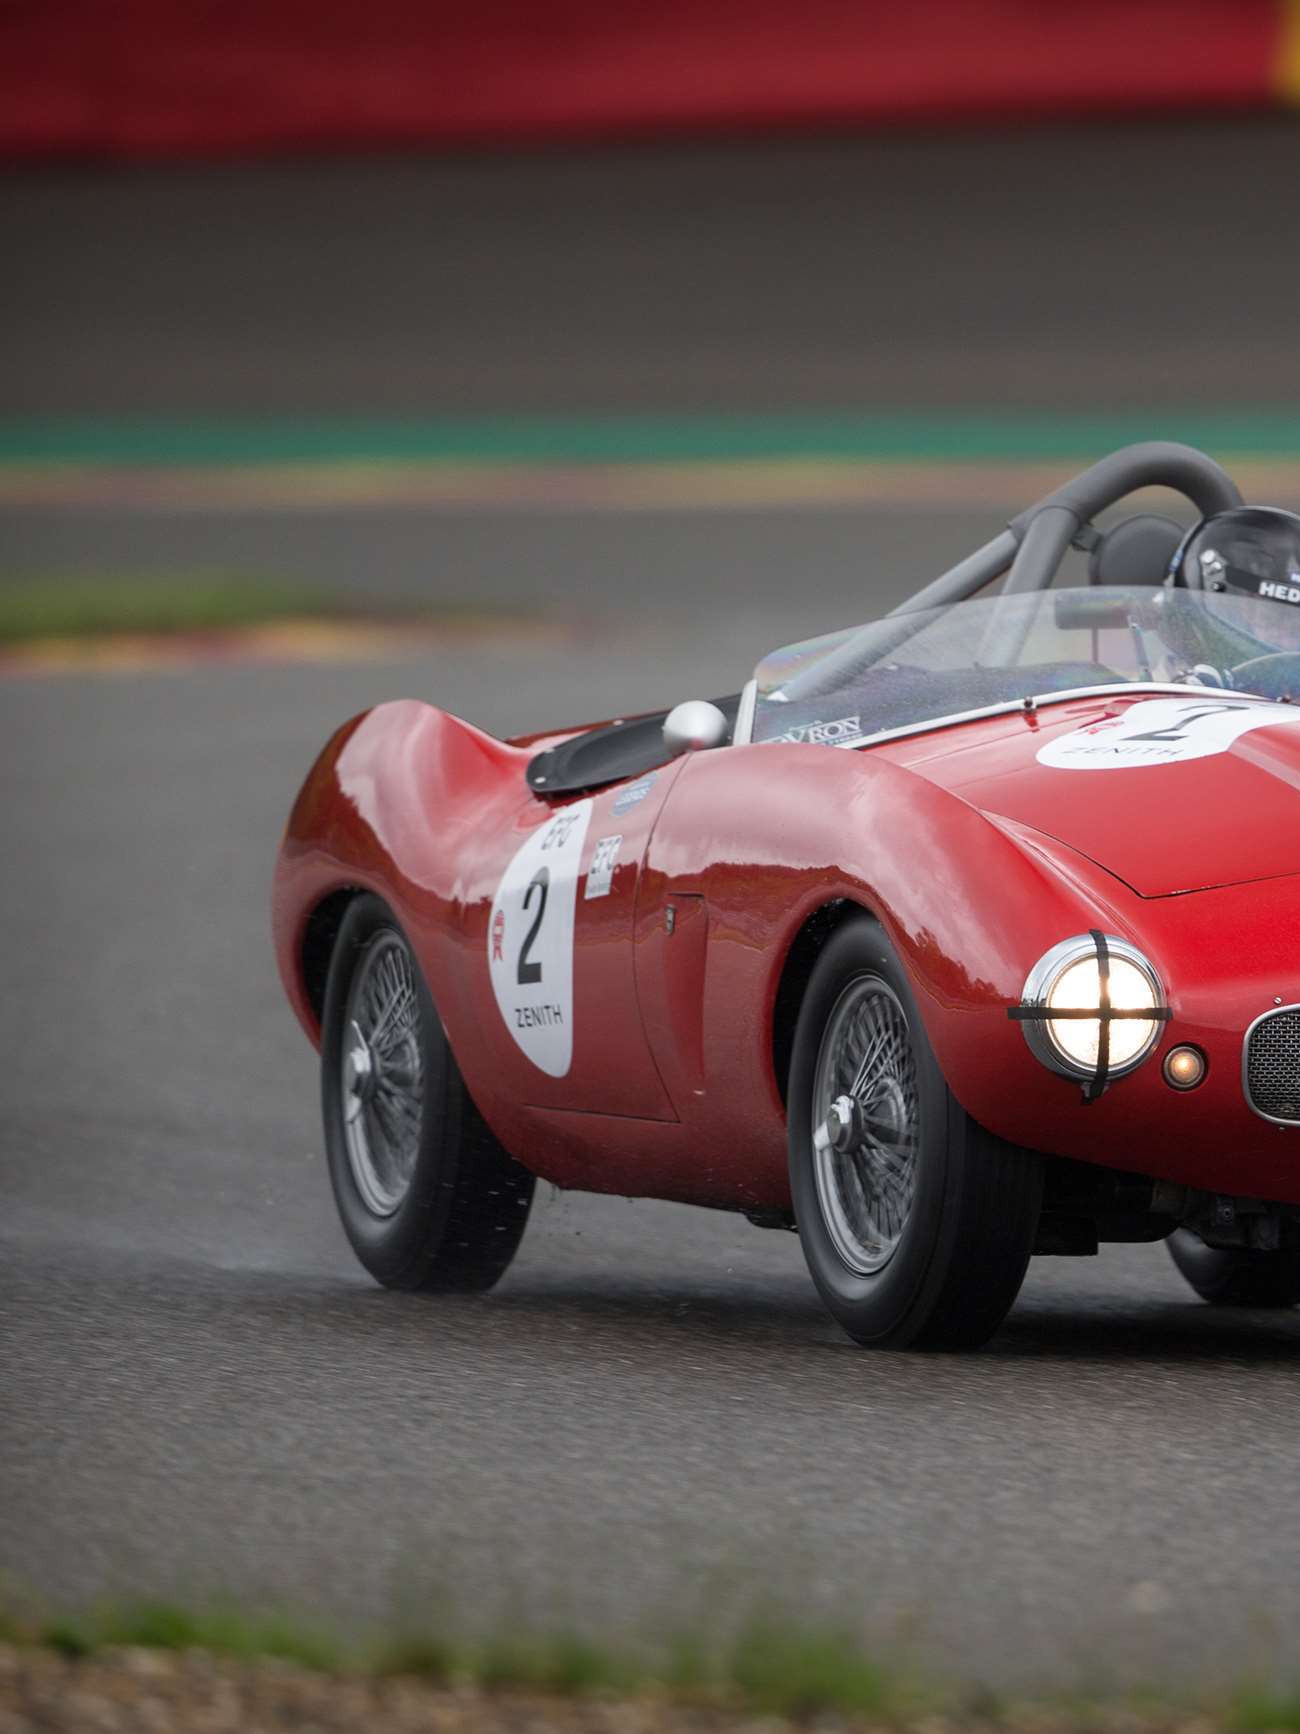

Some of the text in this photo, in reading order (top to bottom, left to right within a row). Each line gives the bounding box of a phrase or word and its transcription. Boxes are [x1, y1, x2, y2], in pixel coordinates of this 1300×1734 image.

[1119, 704, 1251, 741] 2
[1060, 747, 1184, 756] ZENITH
[516, 866, 550, 985] 2
[514, 1004, 564, 1028] ZENITH
